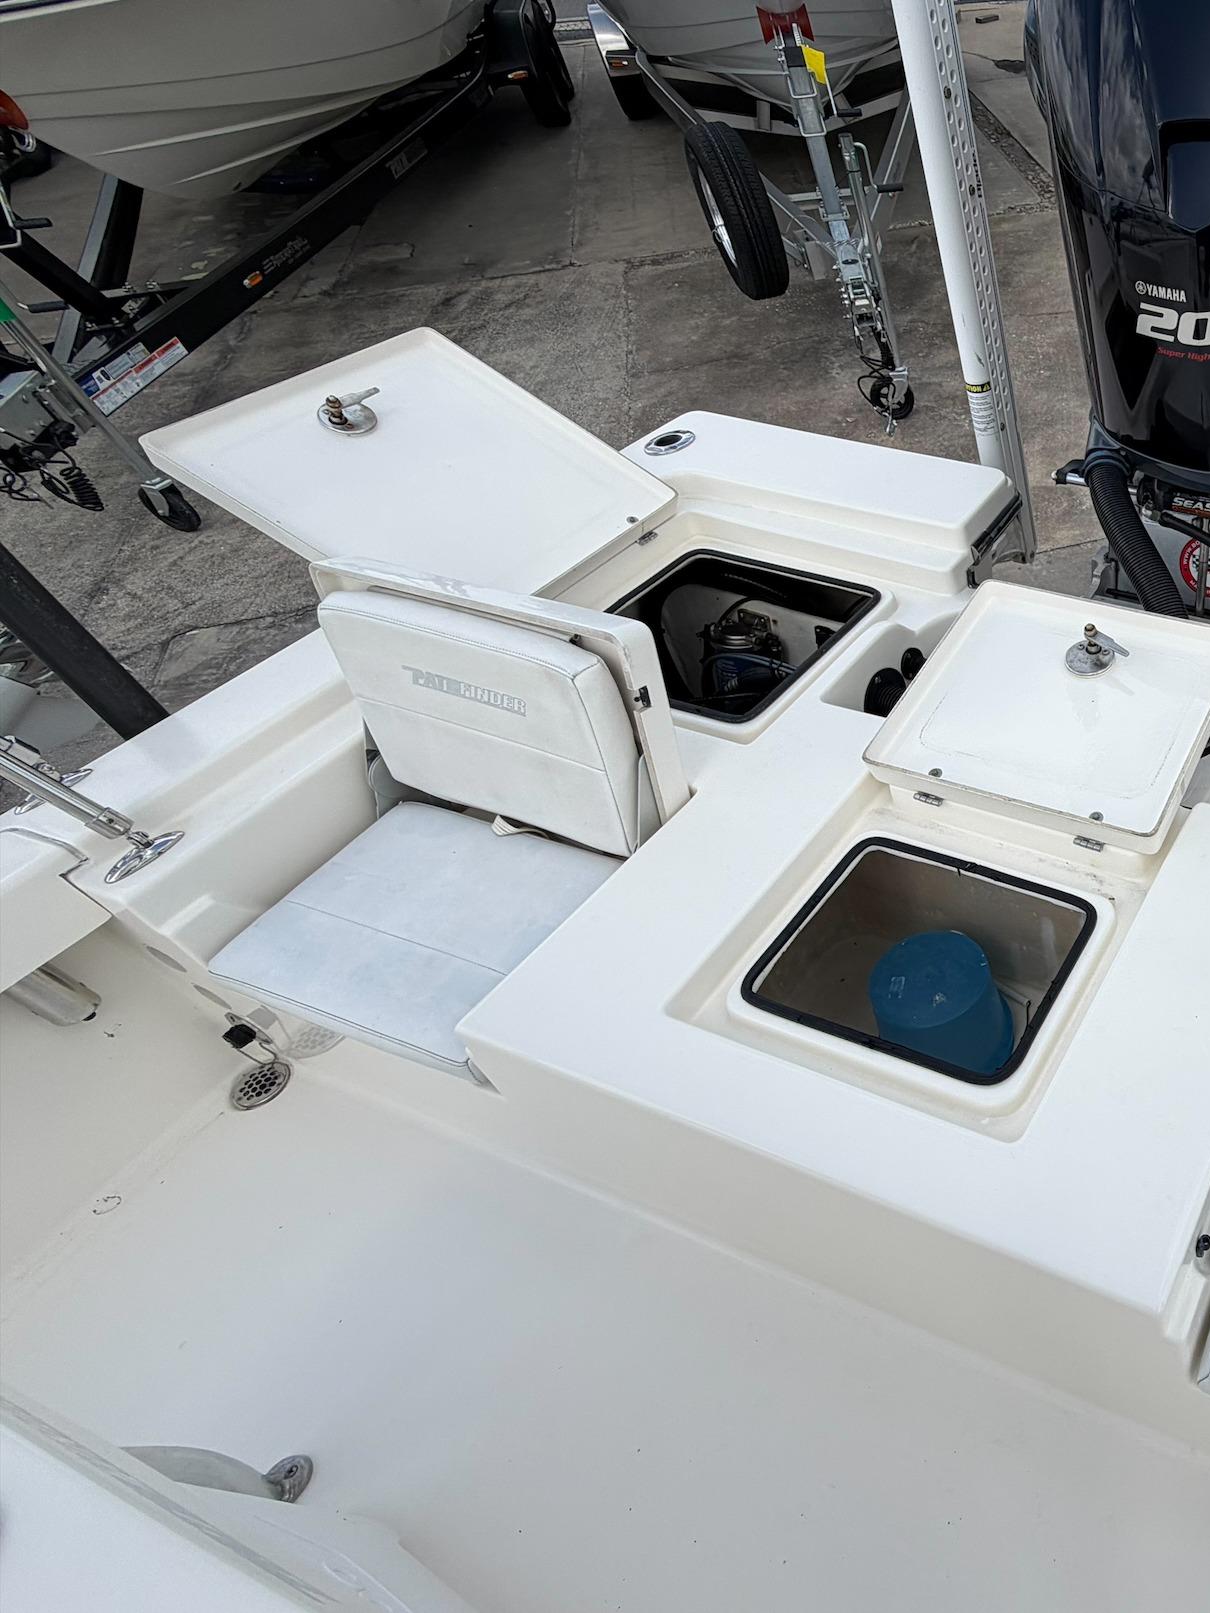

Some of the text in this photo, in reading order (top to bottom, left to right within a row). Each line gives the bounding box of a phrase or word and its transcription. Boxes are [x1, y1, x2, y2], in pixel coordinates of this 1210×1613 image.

[1146, 283, 1187, 303] YAMAHA
[1157, 347, 1186, 359] Super
[1187, 351, 1210, 362] High
